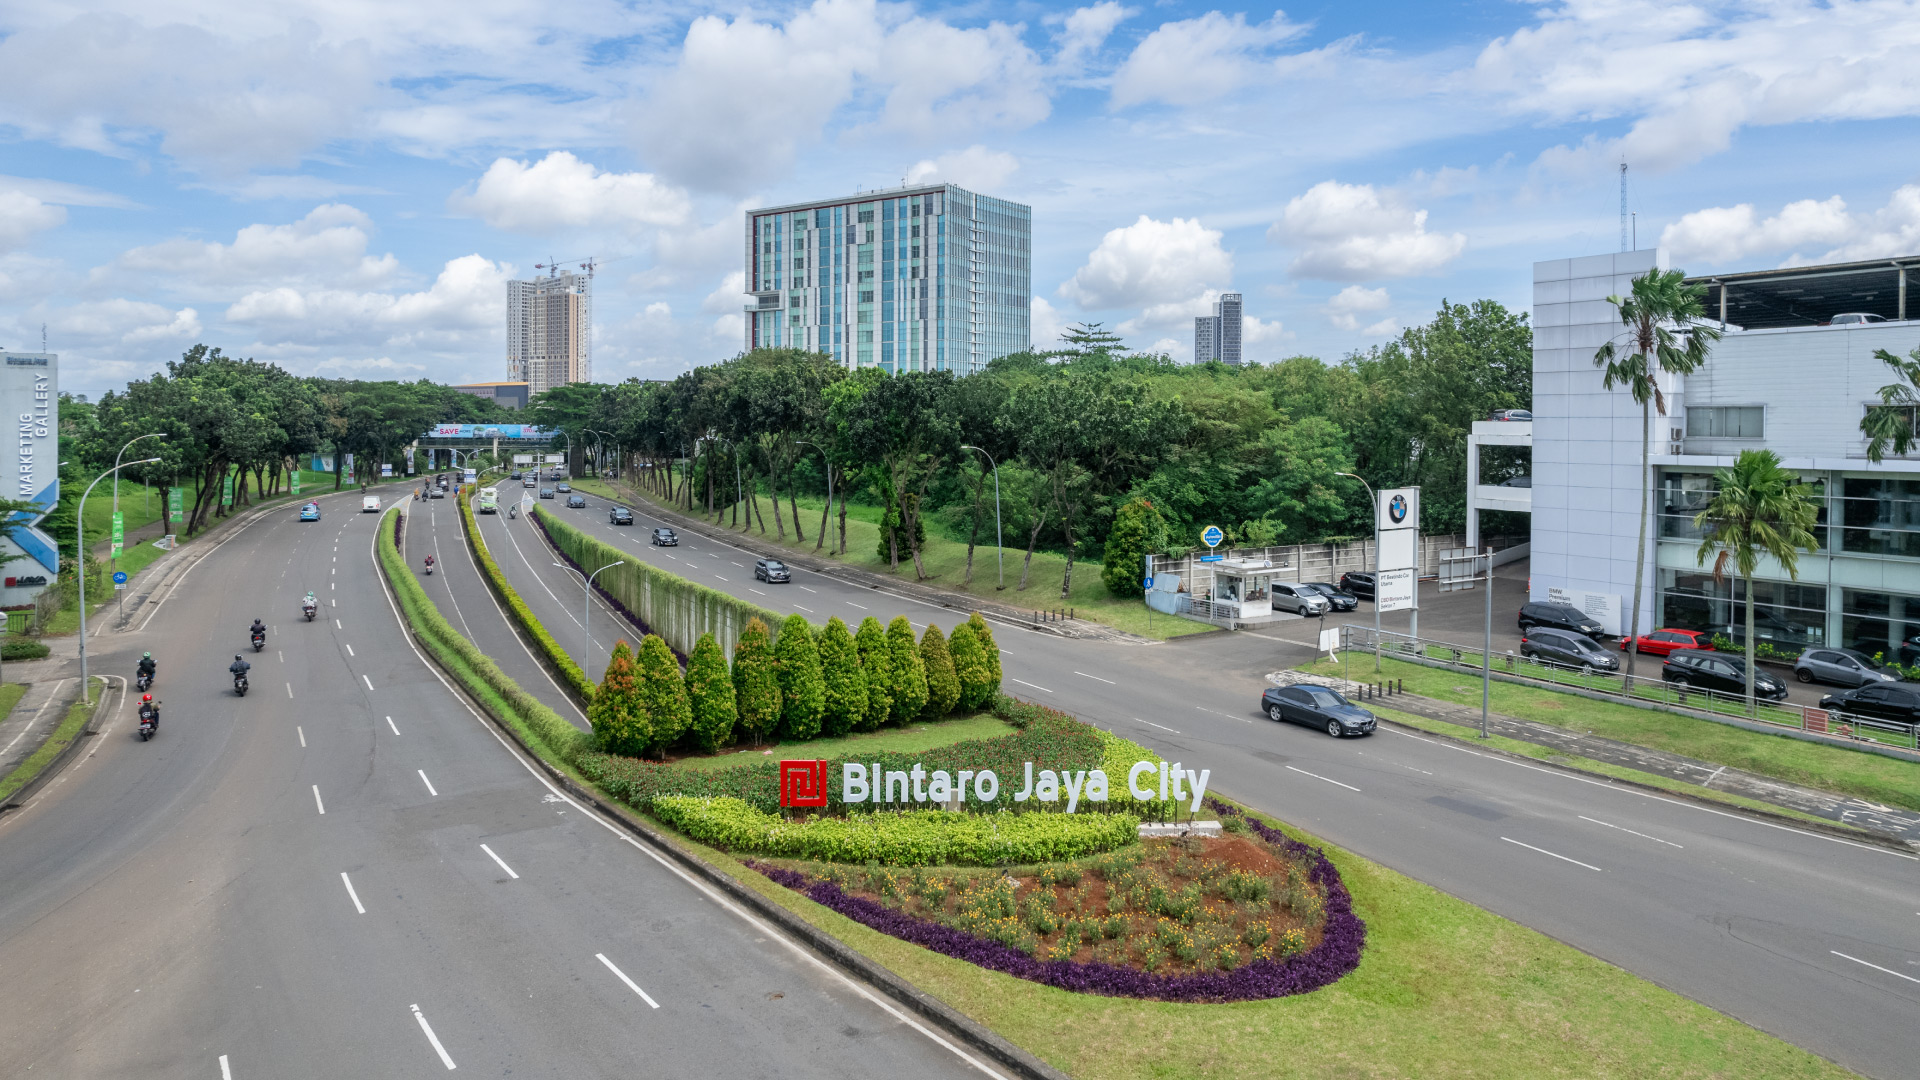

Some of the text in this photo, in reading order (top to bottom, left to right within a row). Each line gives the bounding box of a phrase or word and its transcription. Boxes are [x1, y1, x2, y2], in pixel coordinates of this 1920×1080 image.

[35, 372, 48, 438] GALLERY
[19, 412, 33, 496] MARKETING
[1390, 495, 1407, 505] BMW
[842, 760, 1211, 814] Bintaro Jaya City
